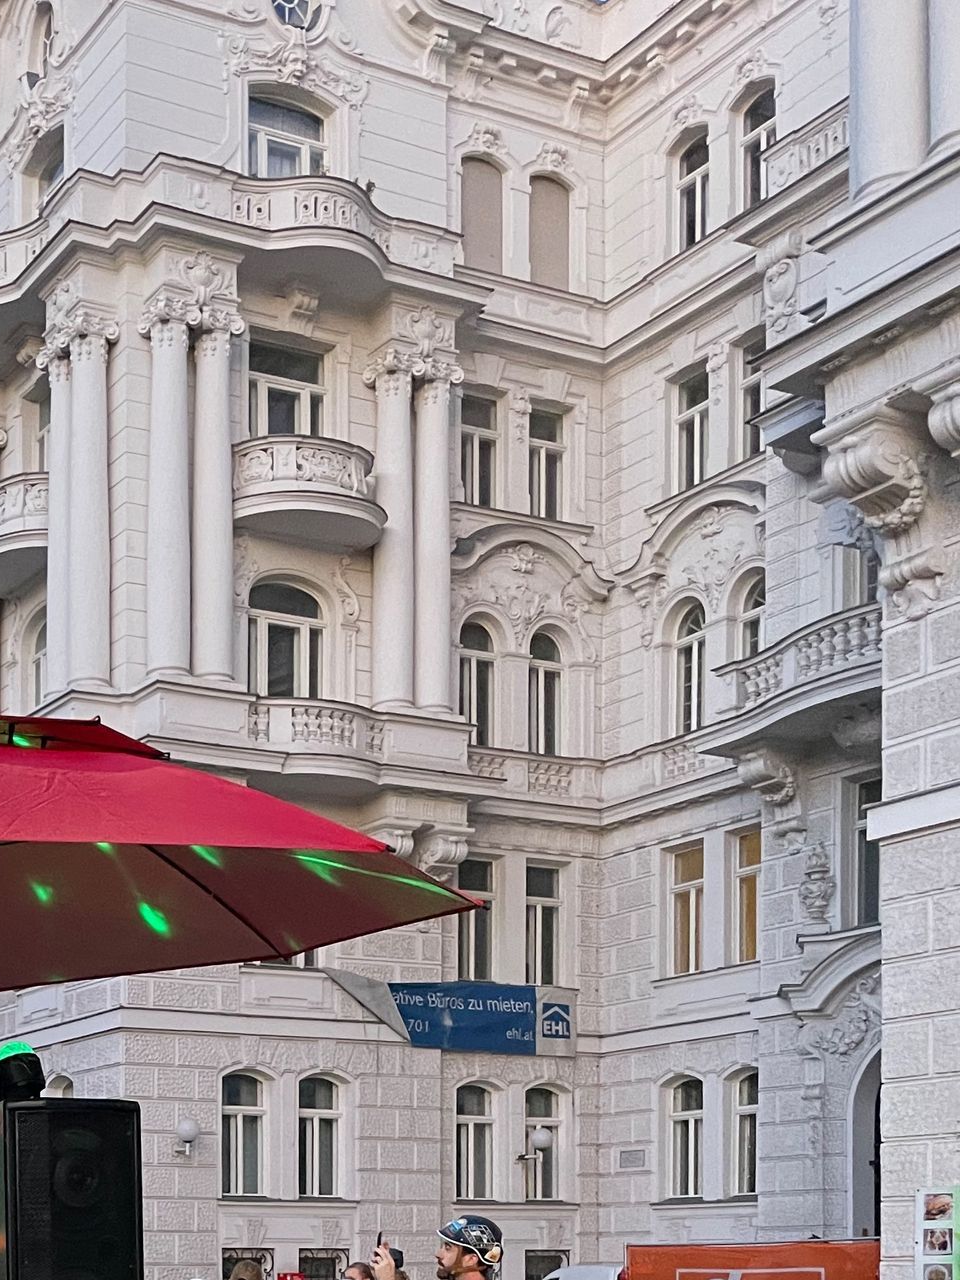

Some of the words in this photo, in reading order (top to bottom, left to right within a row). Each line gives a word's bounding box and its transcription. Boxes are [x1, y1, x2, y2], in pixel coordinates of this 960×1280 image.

[427, 992, 465, 1010] Büros
[467, 998, 484, 1011] zu
[486, 996, 534, 1014] mieten.
[407, 1018, 430, 1033] 701
[543, 1020, 570, 1036] EHL
[505, 1027, 534, 1041] ehl.at
